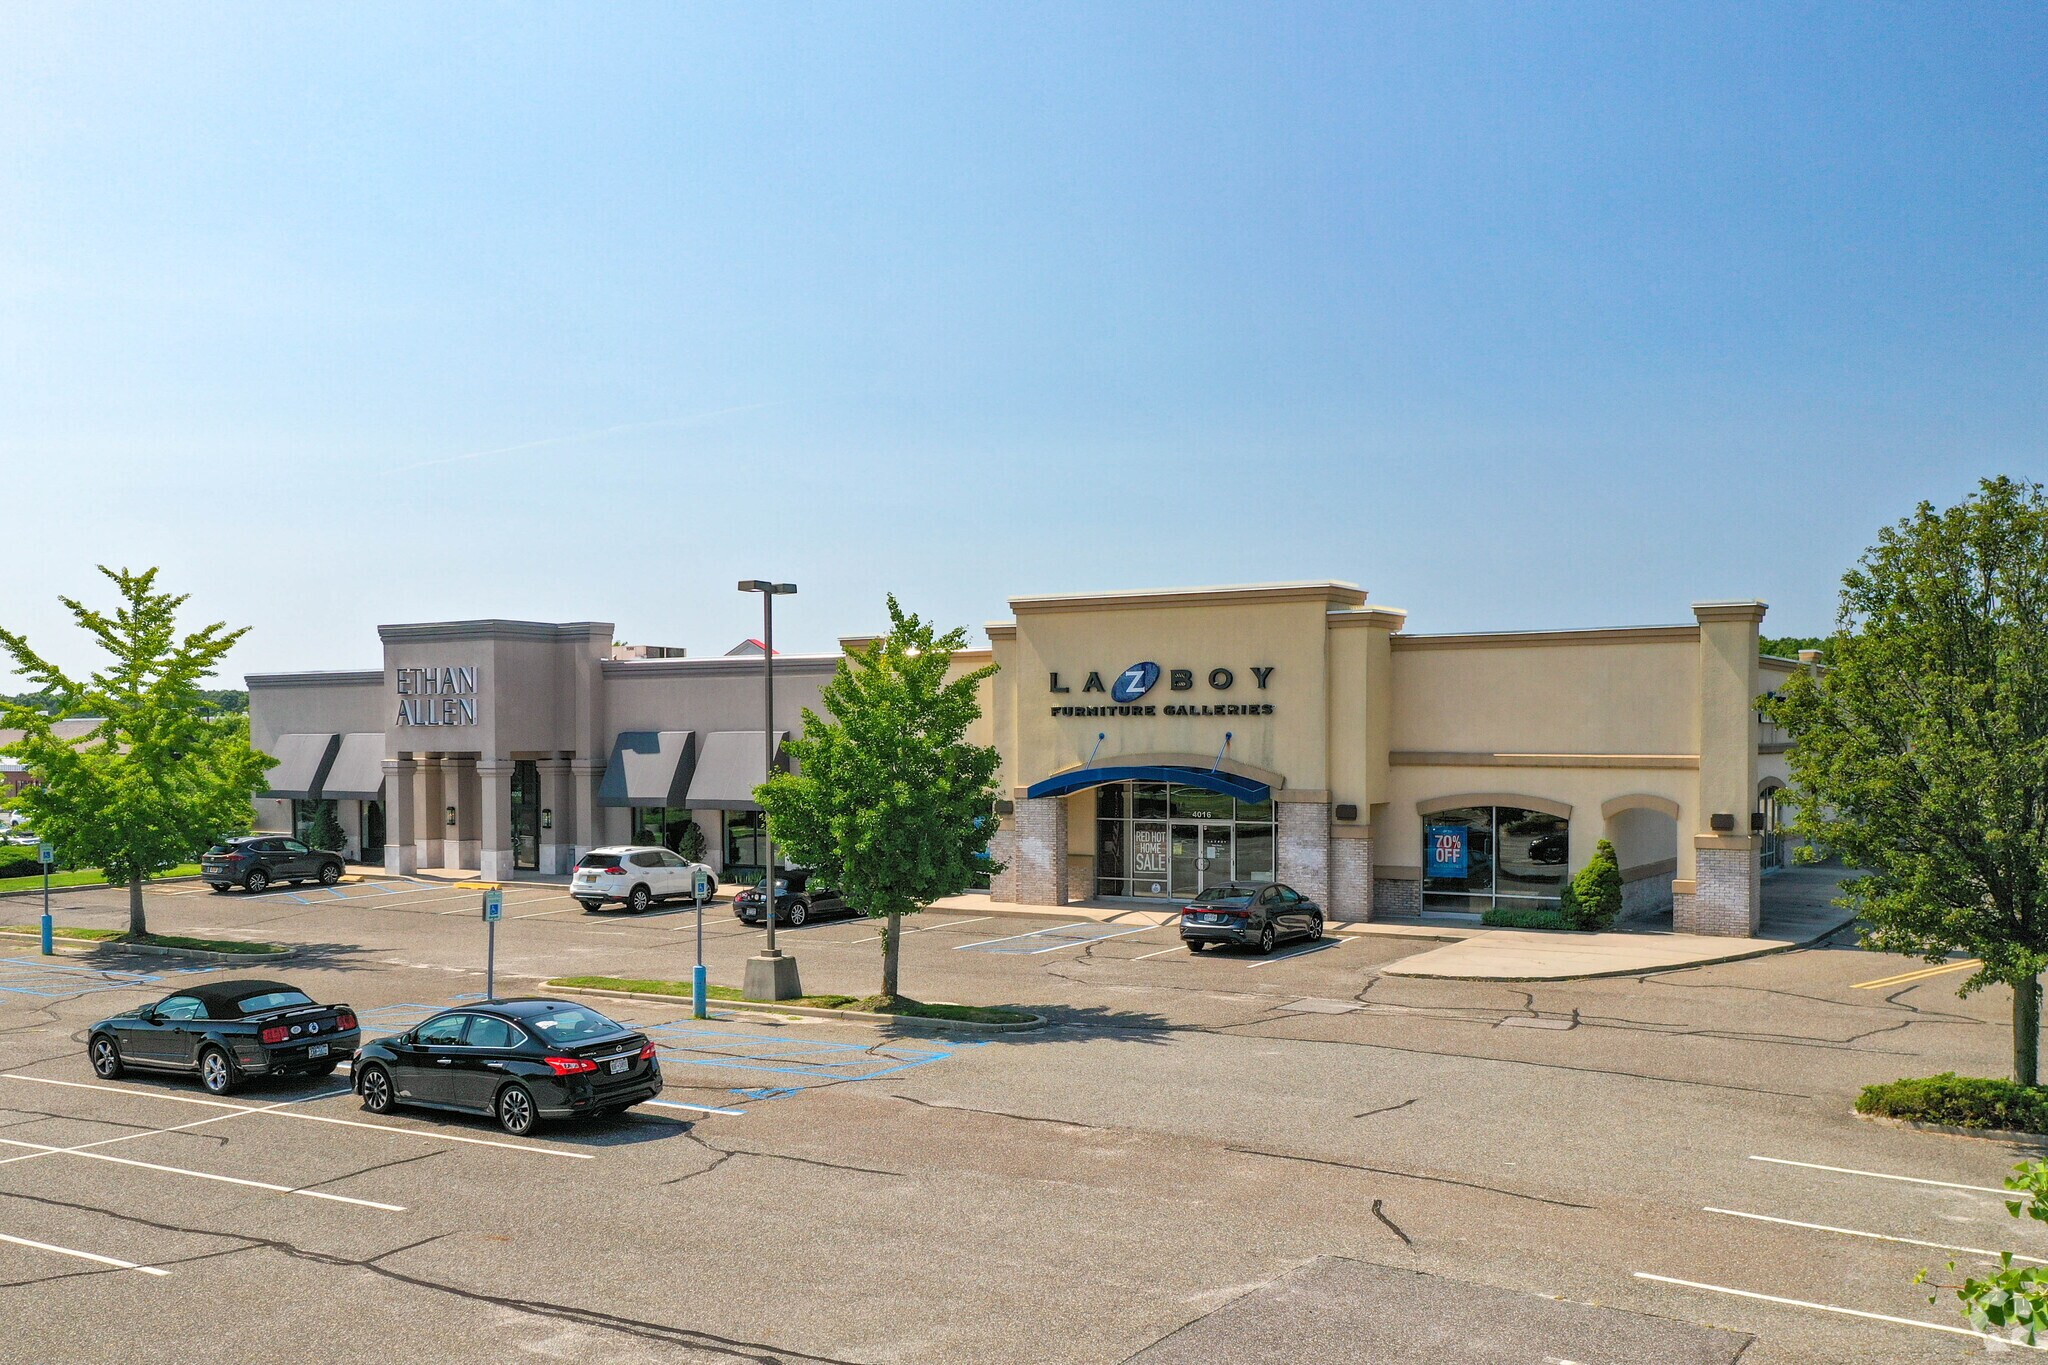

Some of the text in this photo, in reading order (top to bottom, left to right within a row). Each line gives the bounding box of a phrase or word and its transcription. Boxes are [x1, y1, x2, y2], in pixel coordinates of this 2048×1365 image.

[397, 667, 478, 695] ETHAN
[395, 698, 478, 726] ALLEN
[1051, 703, 1274, 718] FURNITURE GALLERIES
[1191, 811, 1212, 819] 4016
[1135, 831, 1166, 843] RED HOT
[1434, 834, 1462, 849] 70%
[1140, 842, 1162, 854] HOME
[1435, 848, 1461, 863] OFF
[1136, 853, 1166, 871] SALE
